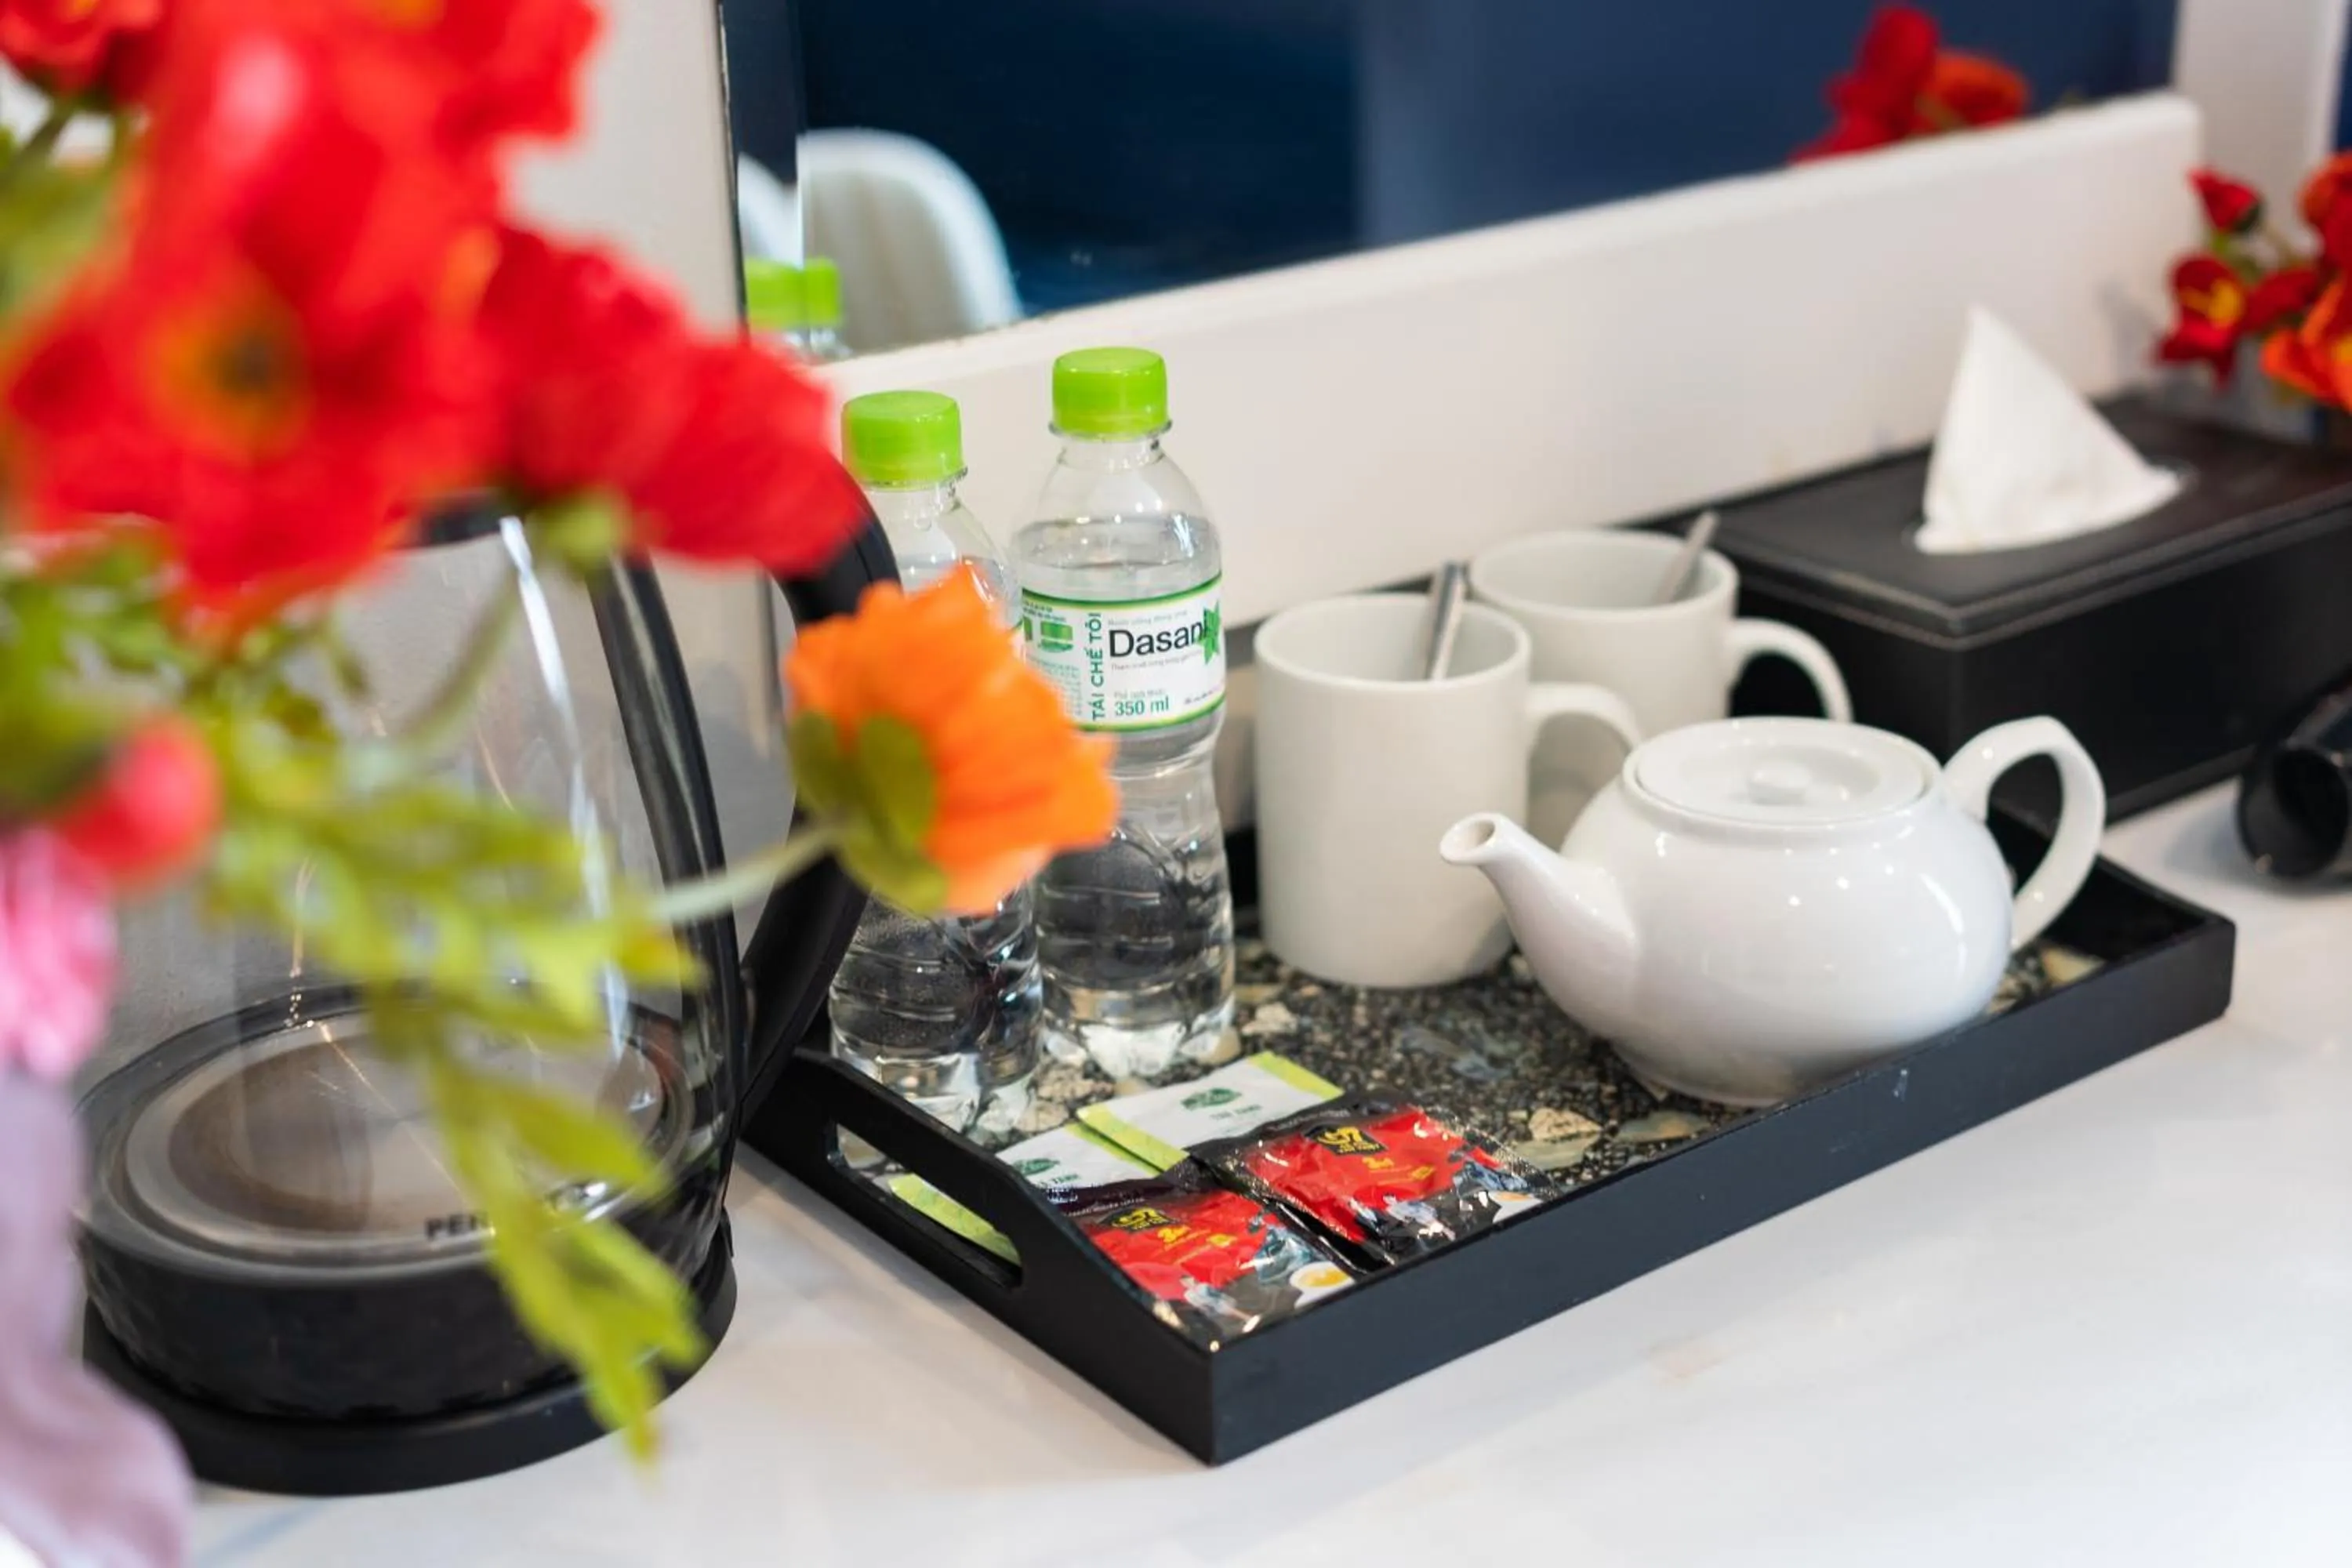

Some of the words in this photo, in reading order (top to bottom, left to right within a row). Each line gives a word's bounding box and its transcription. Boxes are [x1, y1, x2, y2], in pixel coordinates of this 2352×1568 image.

[1084, 613, 1102, 644] TÔI
[1114, 699, 1145, 716] 350
[1150, 695, 1169, 713] ml
